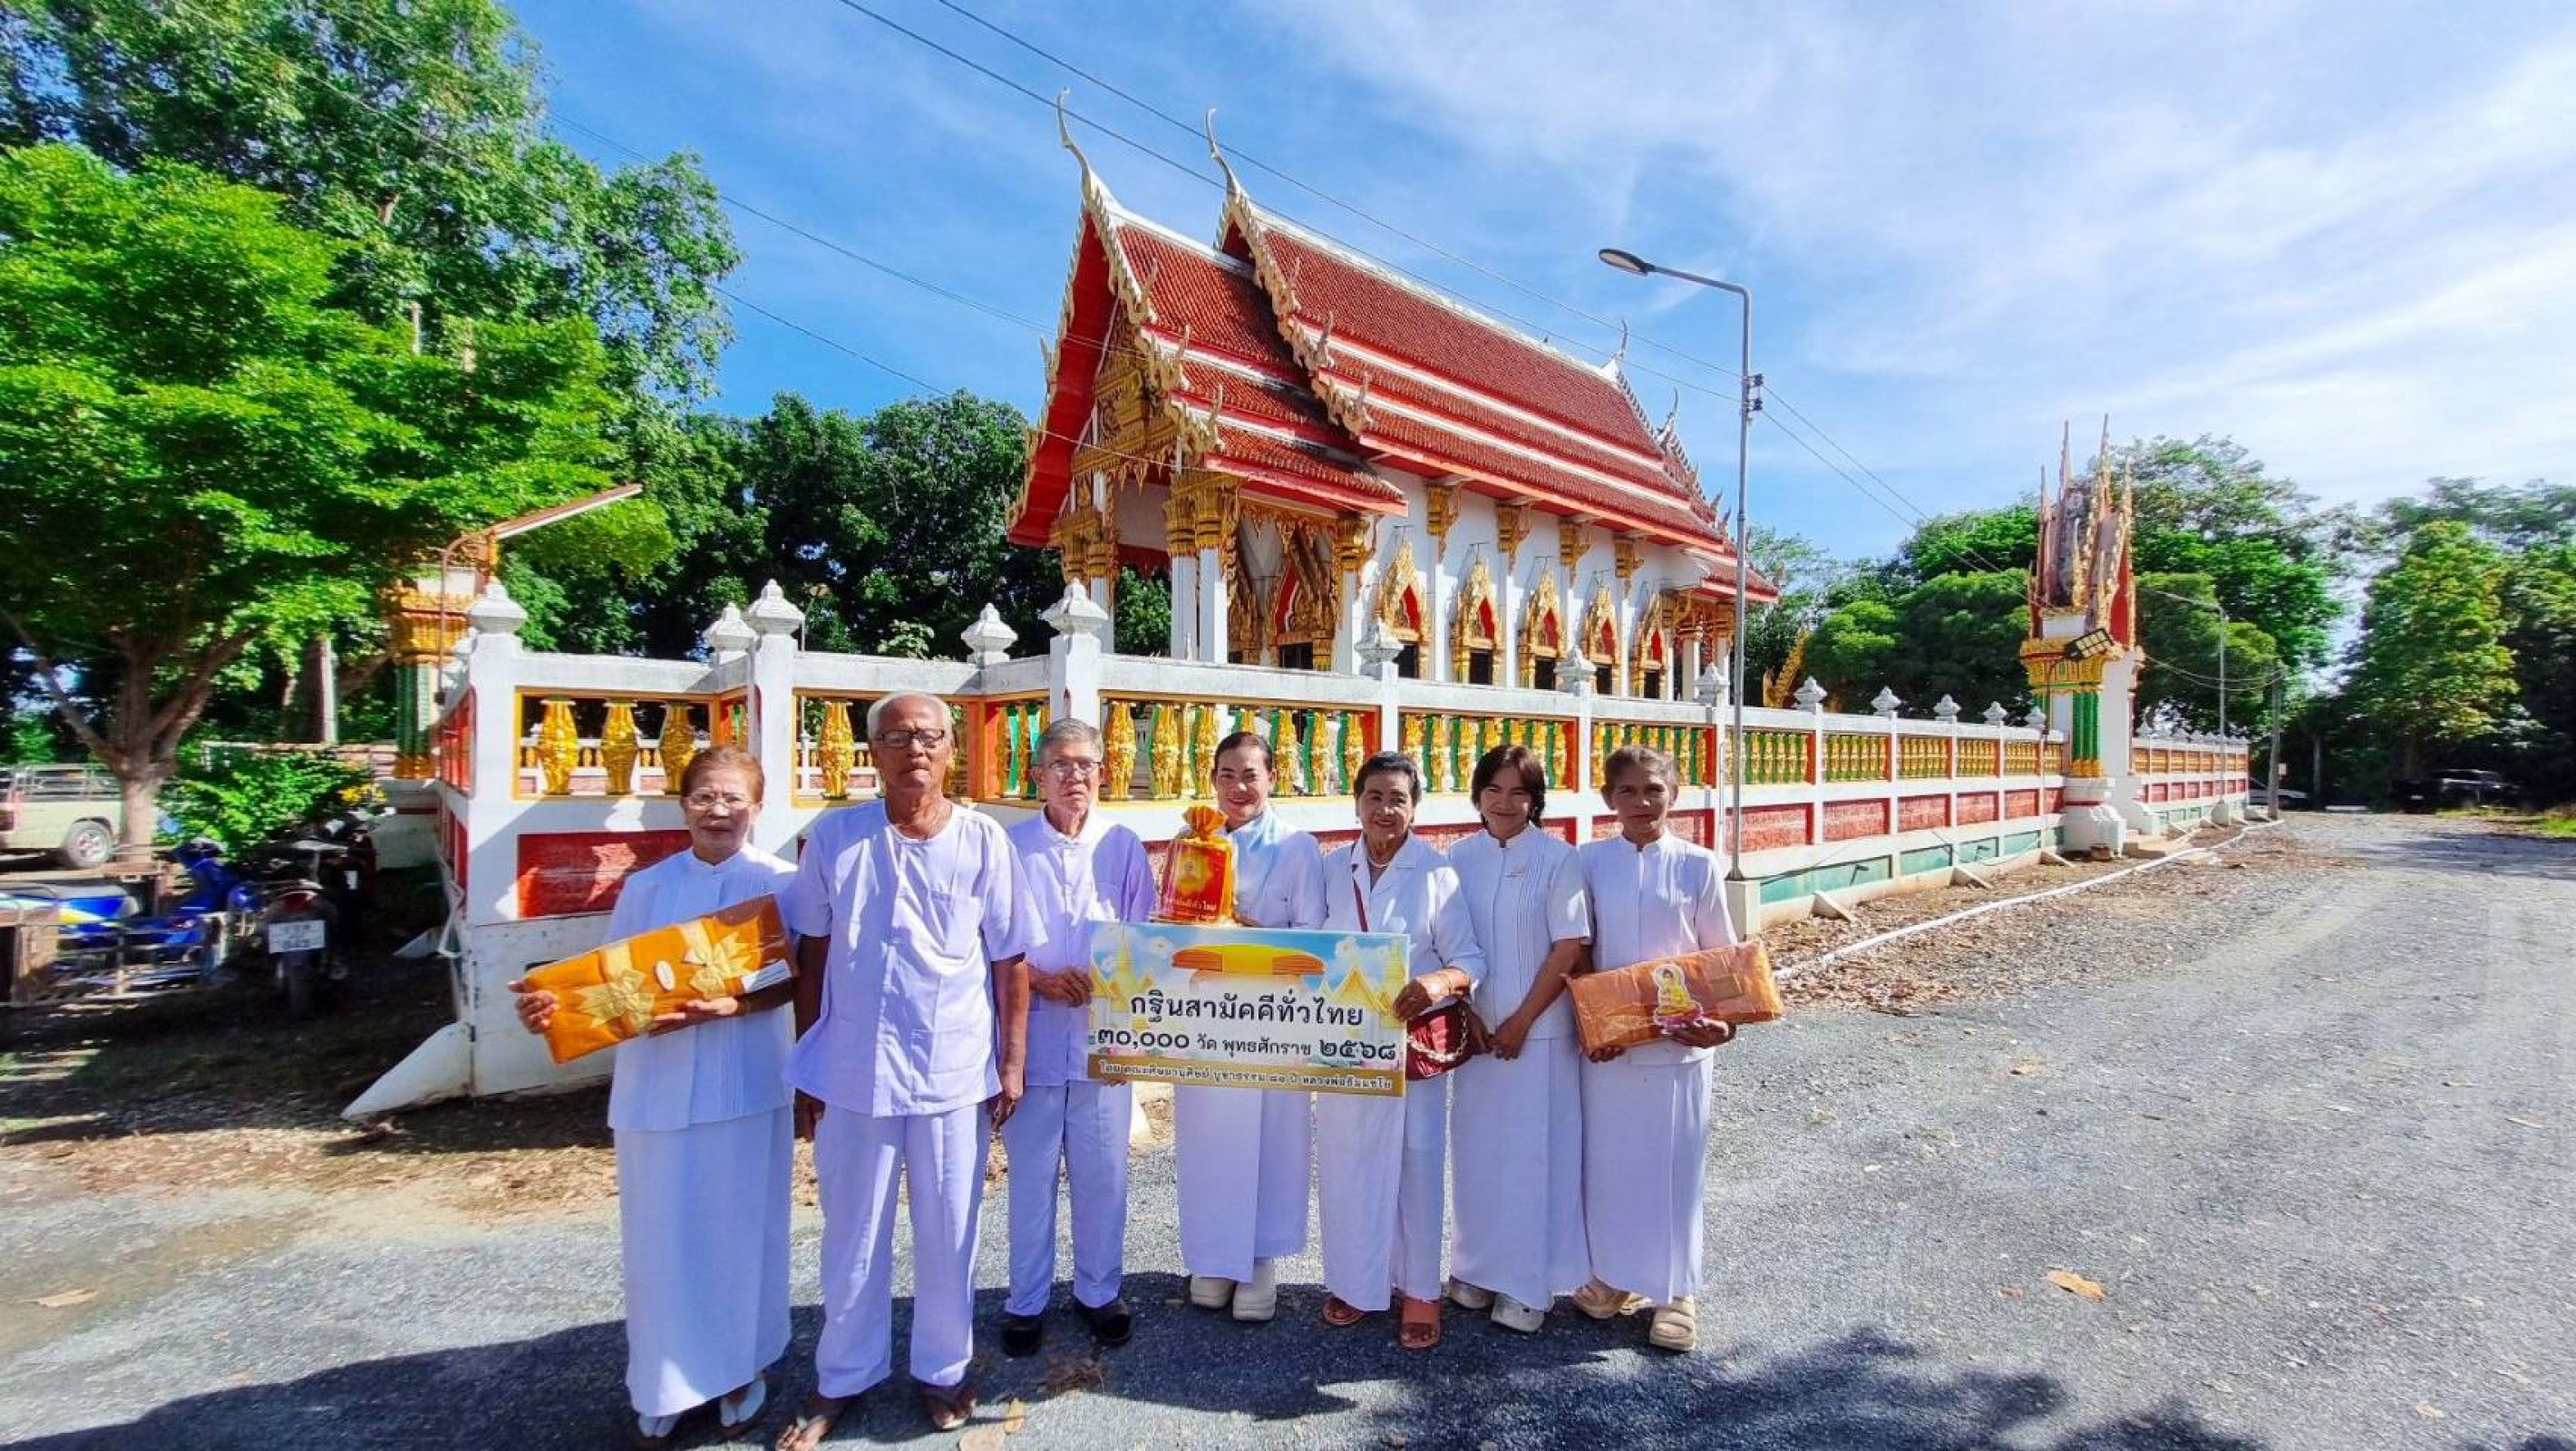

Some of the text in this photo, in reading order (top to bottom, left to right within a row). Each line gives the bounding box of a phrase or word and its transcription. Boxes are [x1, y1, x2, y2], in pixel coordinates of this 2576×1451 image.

[1131, 988, 1364, 1026] กฐินสามัคคีทั่วไทย
[1097, 1027, 1396, 1060] ๓๐,๐๐๐ วัด พุทธศักราช ๒๕๖๘
[1100, 1060, 1121, 1075] โดย
